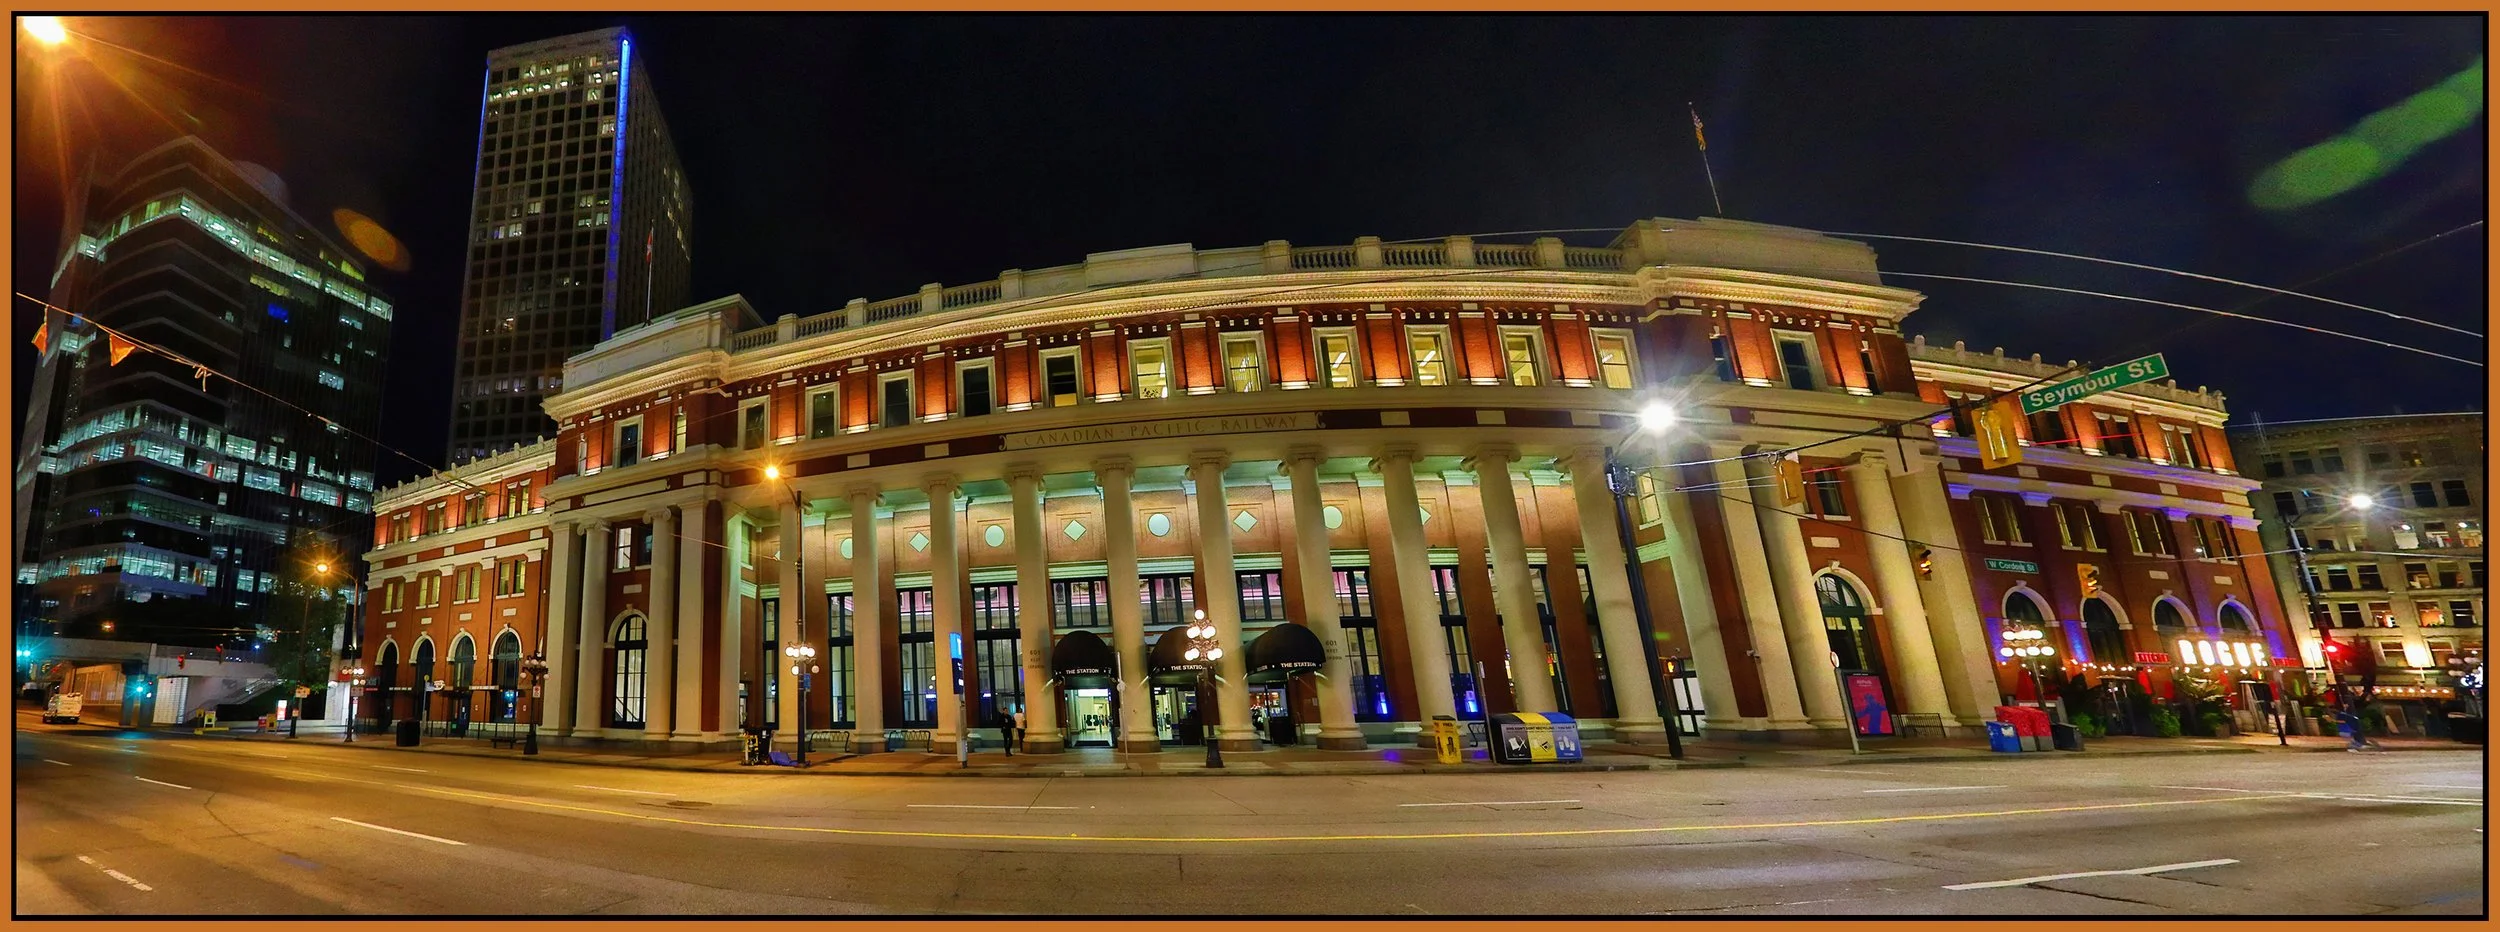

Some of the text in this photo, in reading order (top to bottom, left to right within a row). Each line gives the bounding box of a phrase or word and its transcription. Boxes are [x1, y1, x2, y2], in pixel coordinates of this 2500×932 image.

[2029, 359, 2156, 408] Seymour St
[1024, 415, 1298, 447] CANADIAN PACIFIC RAILWAY
[1988, 560, 1997, 568] W
[2177, 639, 2268, 667] ROGUE
